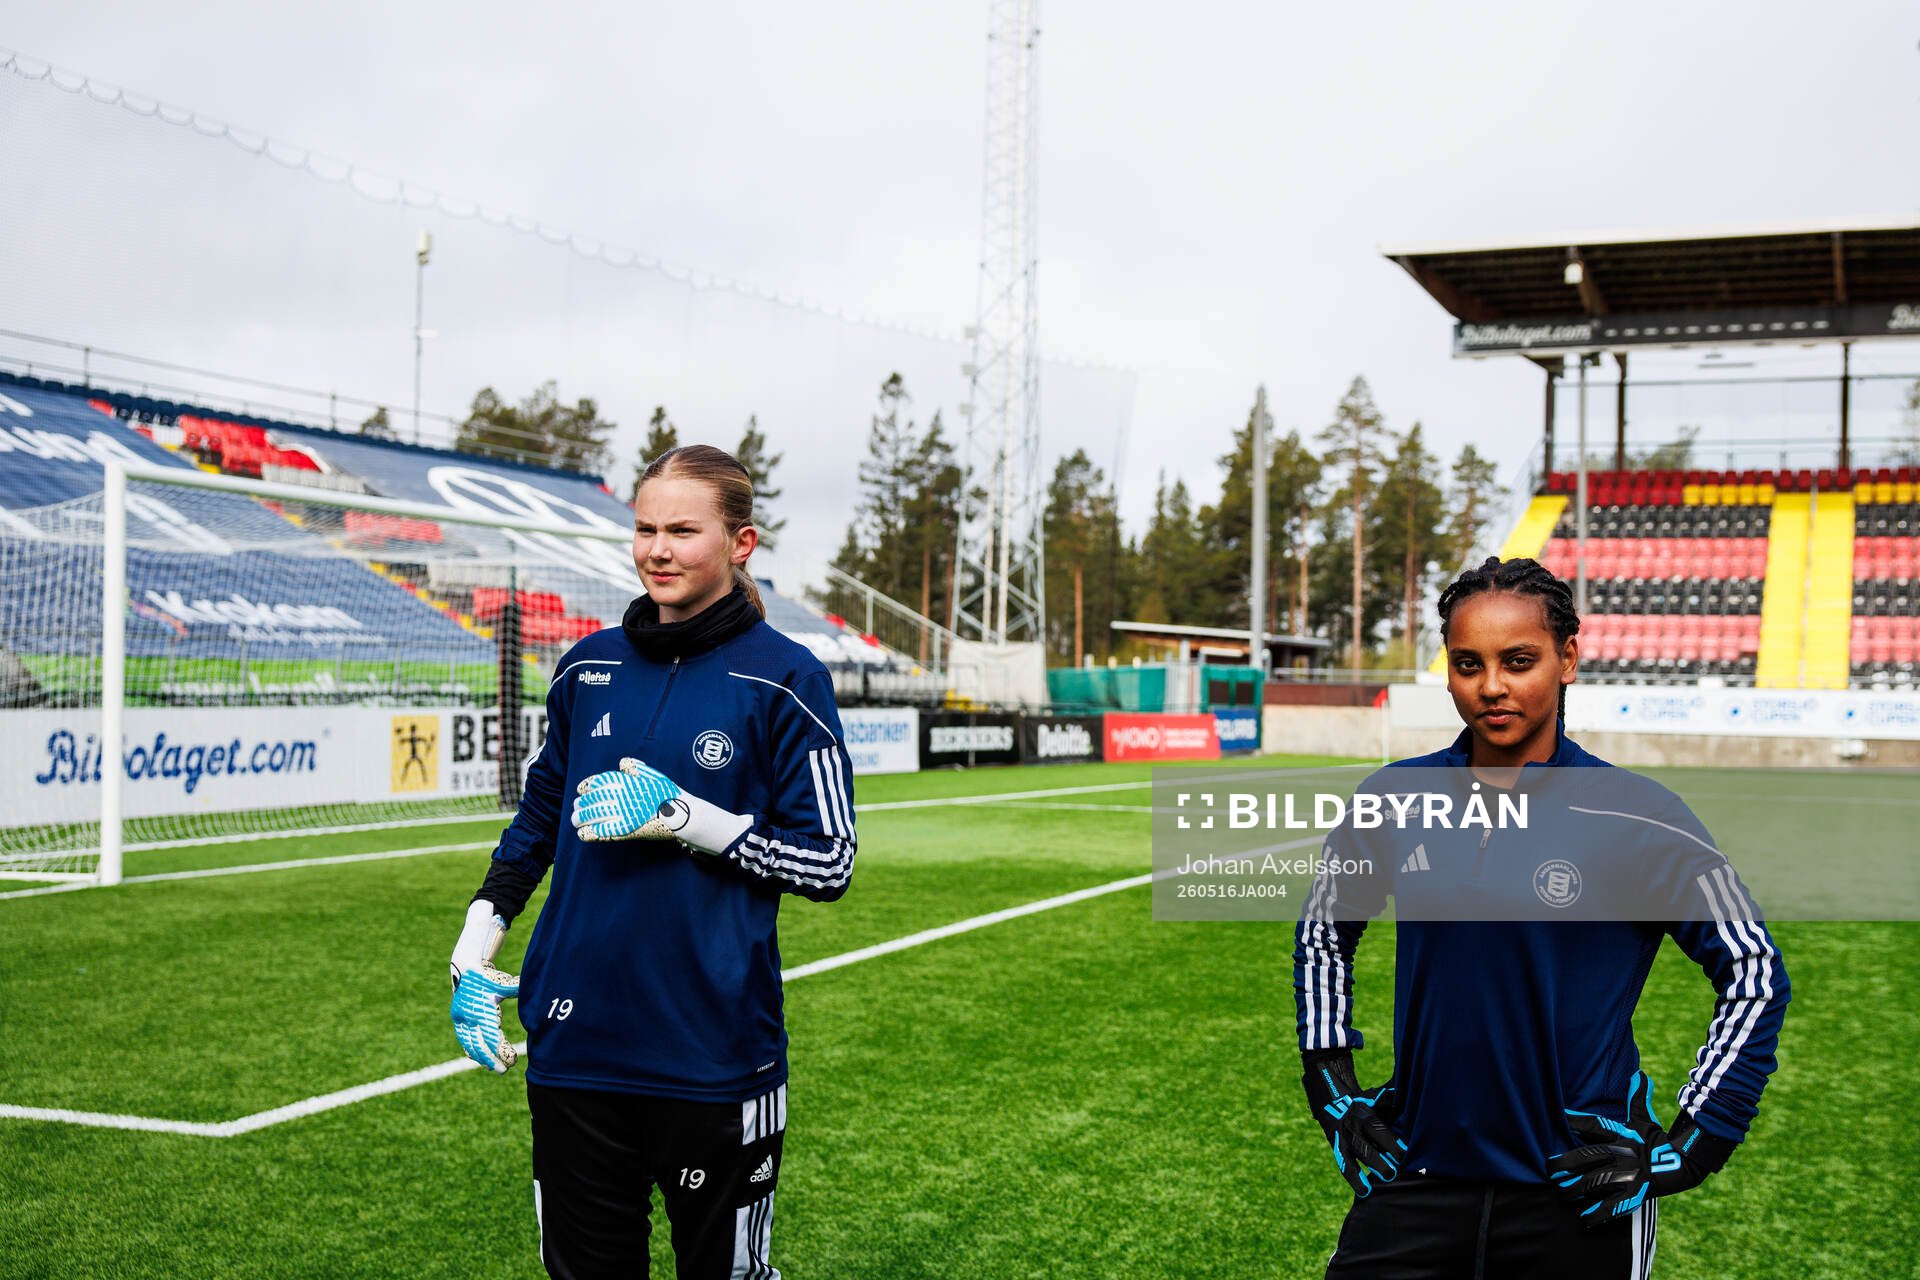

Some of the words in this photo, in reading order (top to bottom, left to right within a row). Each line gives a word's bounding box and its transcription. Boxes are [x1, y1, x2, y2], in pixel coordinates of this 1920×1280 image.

[37, 729, 316, 793] Bilolaget.com
[547, 998, 573, 1021] 19
[679, 1167, 706, 1189] 19
